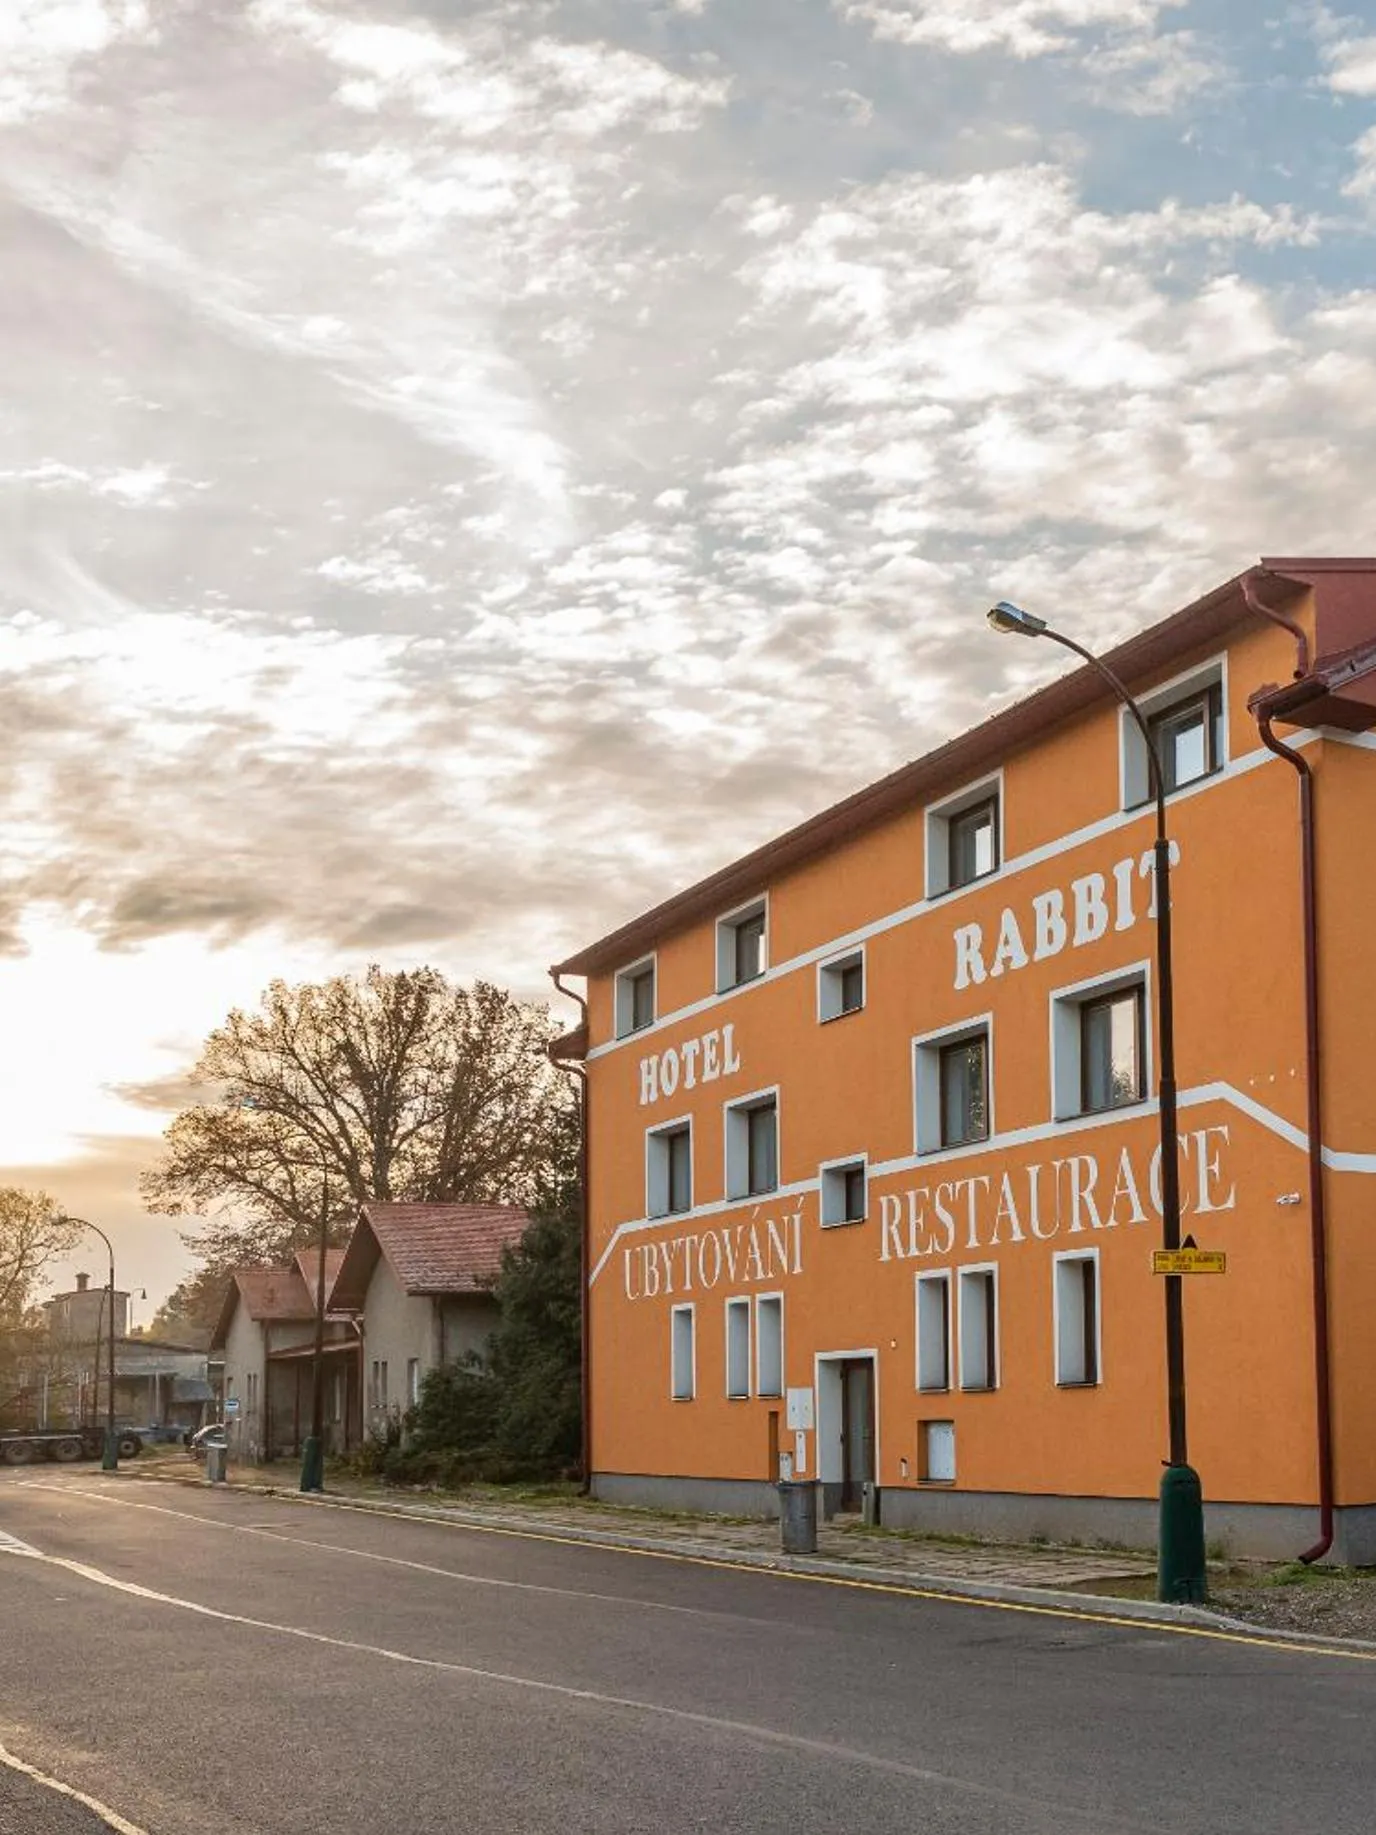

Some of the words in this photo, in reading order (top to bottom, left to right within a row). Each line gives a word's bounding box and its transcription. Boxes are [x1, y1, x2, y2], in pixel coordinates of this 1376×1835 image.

[640, 1023, 740, 1105] HOTEL
[953, 840, 1181, 990] RABBIT
[624, 1195, 805, 1300] UBYTOVÁNÍ
[878, 1125, 1236, 1262] RESTAURACE
